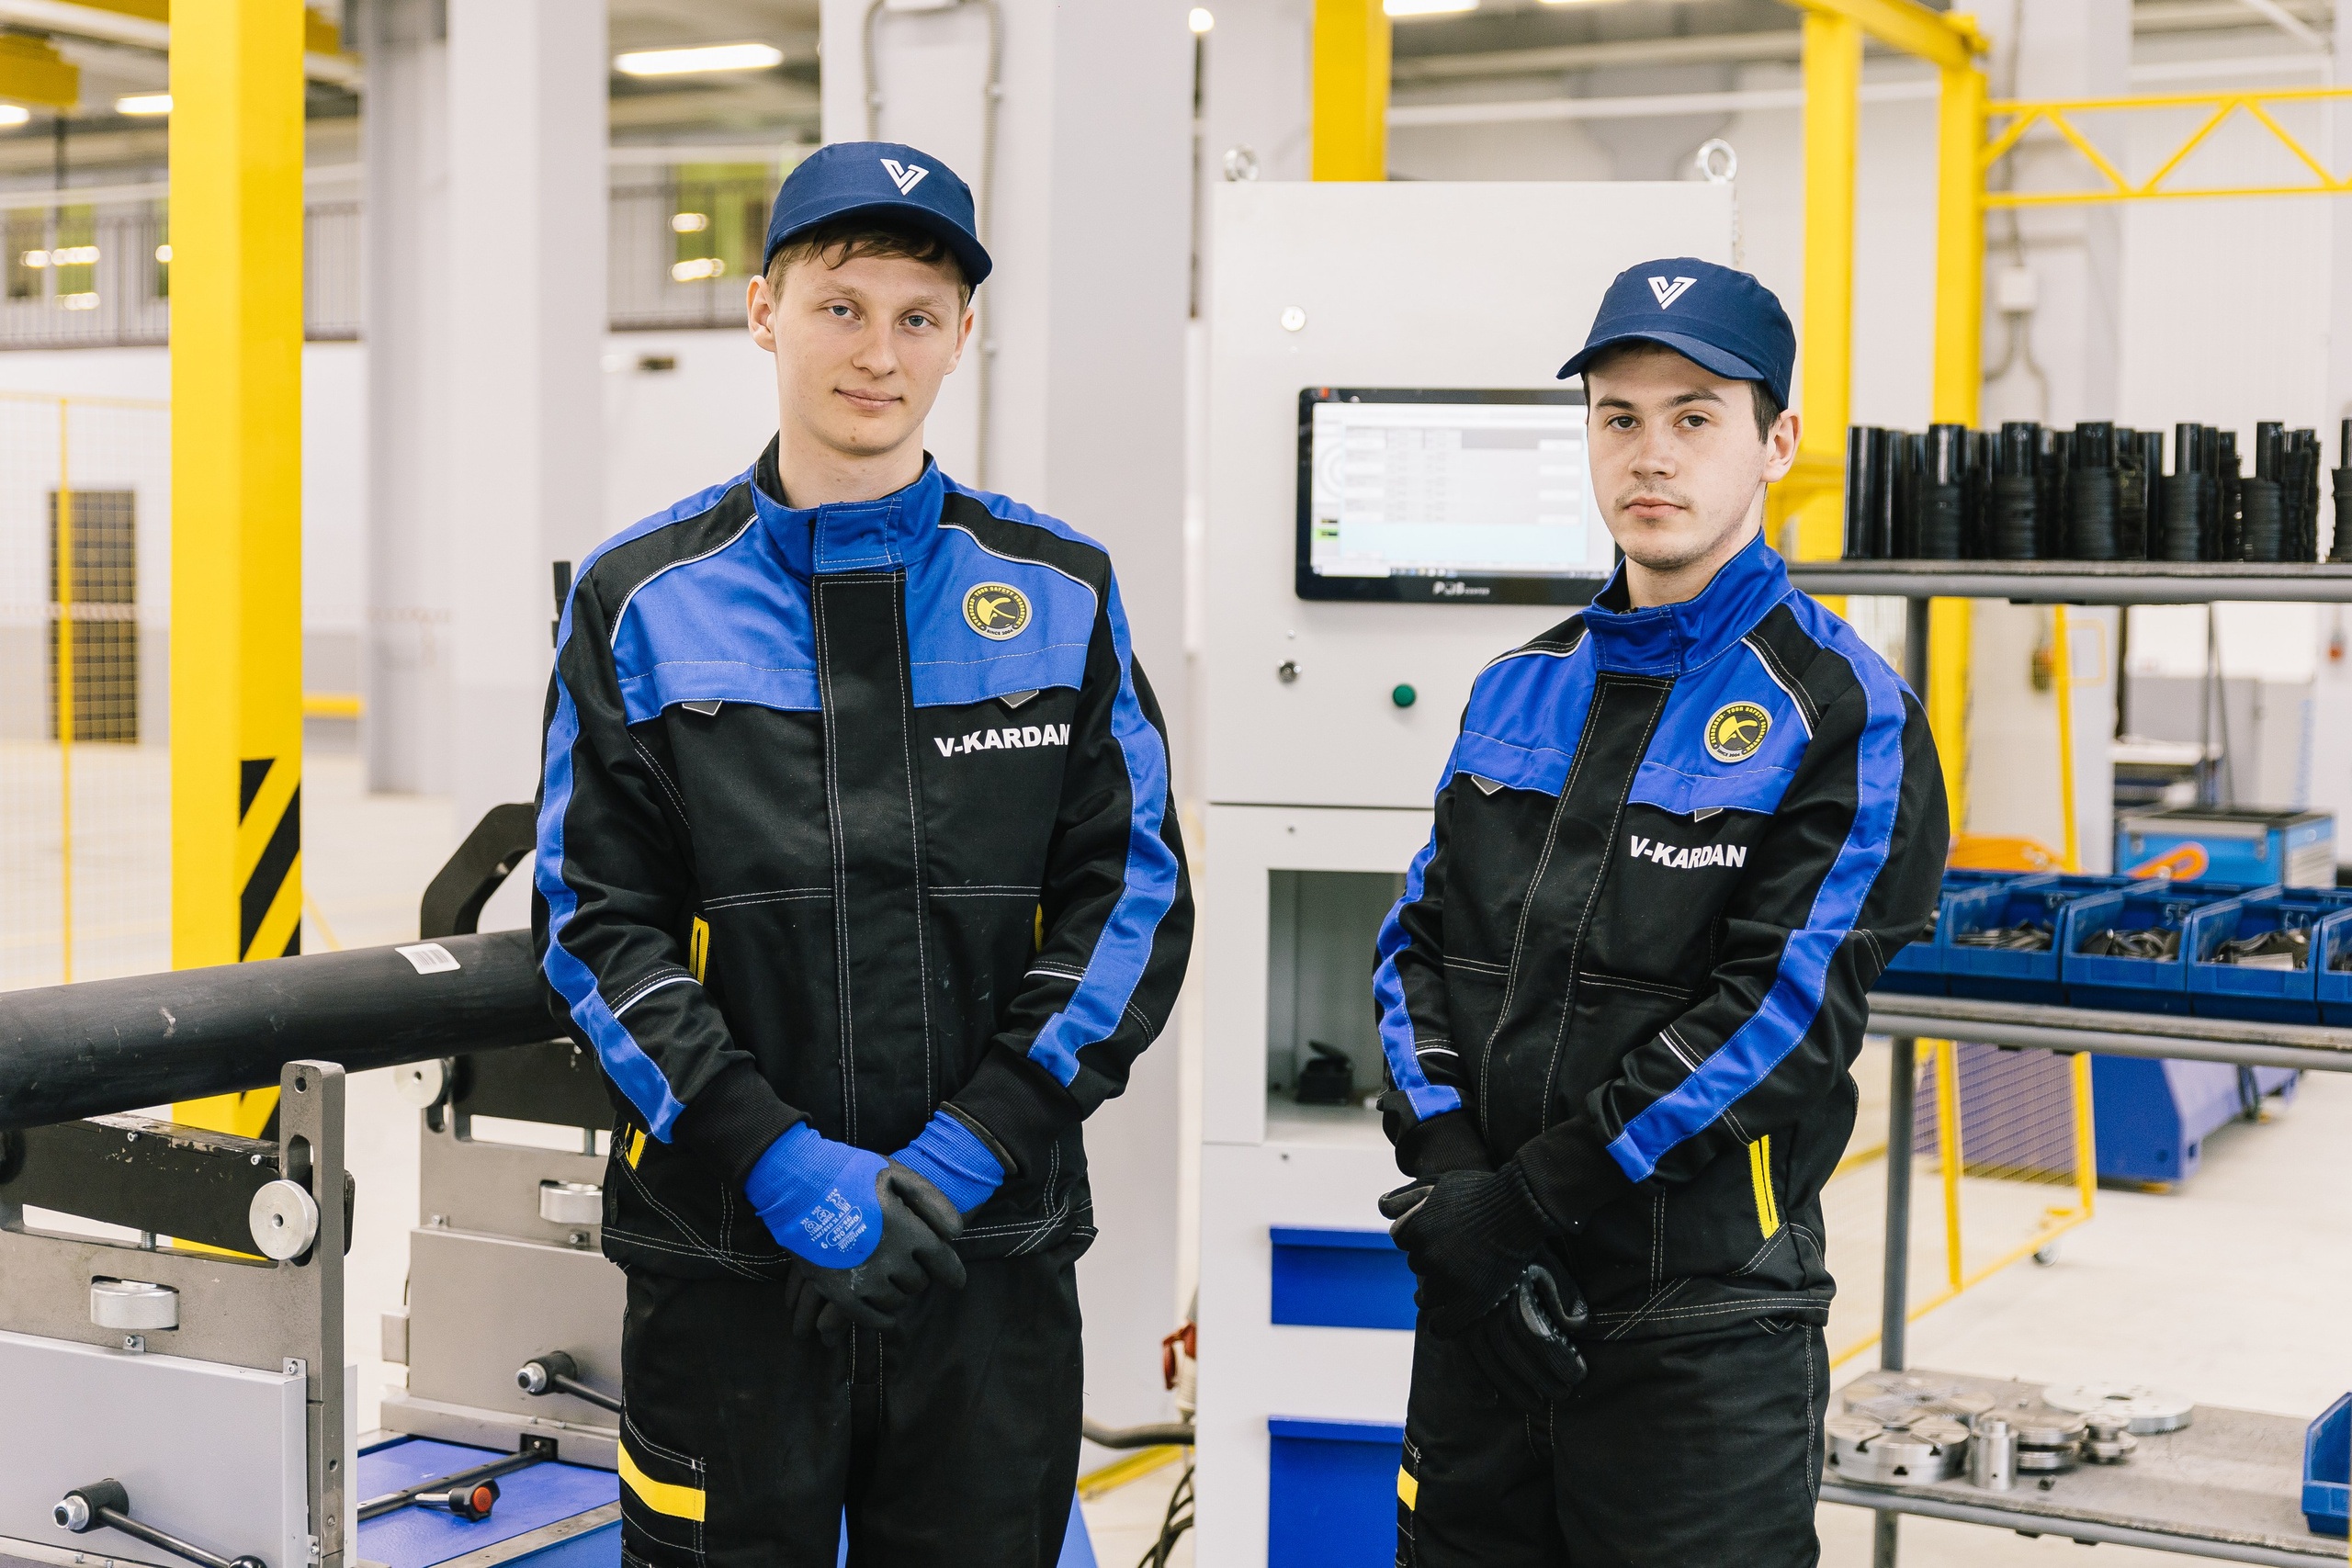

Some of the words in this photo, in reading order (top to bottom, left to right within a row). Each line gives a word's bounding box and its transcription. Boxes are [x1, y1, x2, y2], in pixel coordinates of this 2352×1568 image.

[1745, 706, 1765, 720] SAFETY
[934, 724, 1070, 757] V-KARDAN
[1631, 835, 1747, 868] V-KARDAN
[820, 1241, 828, 1249] 9
